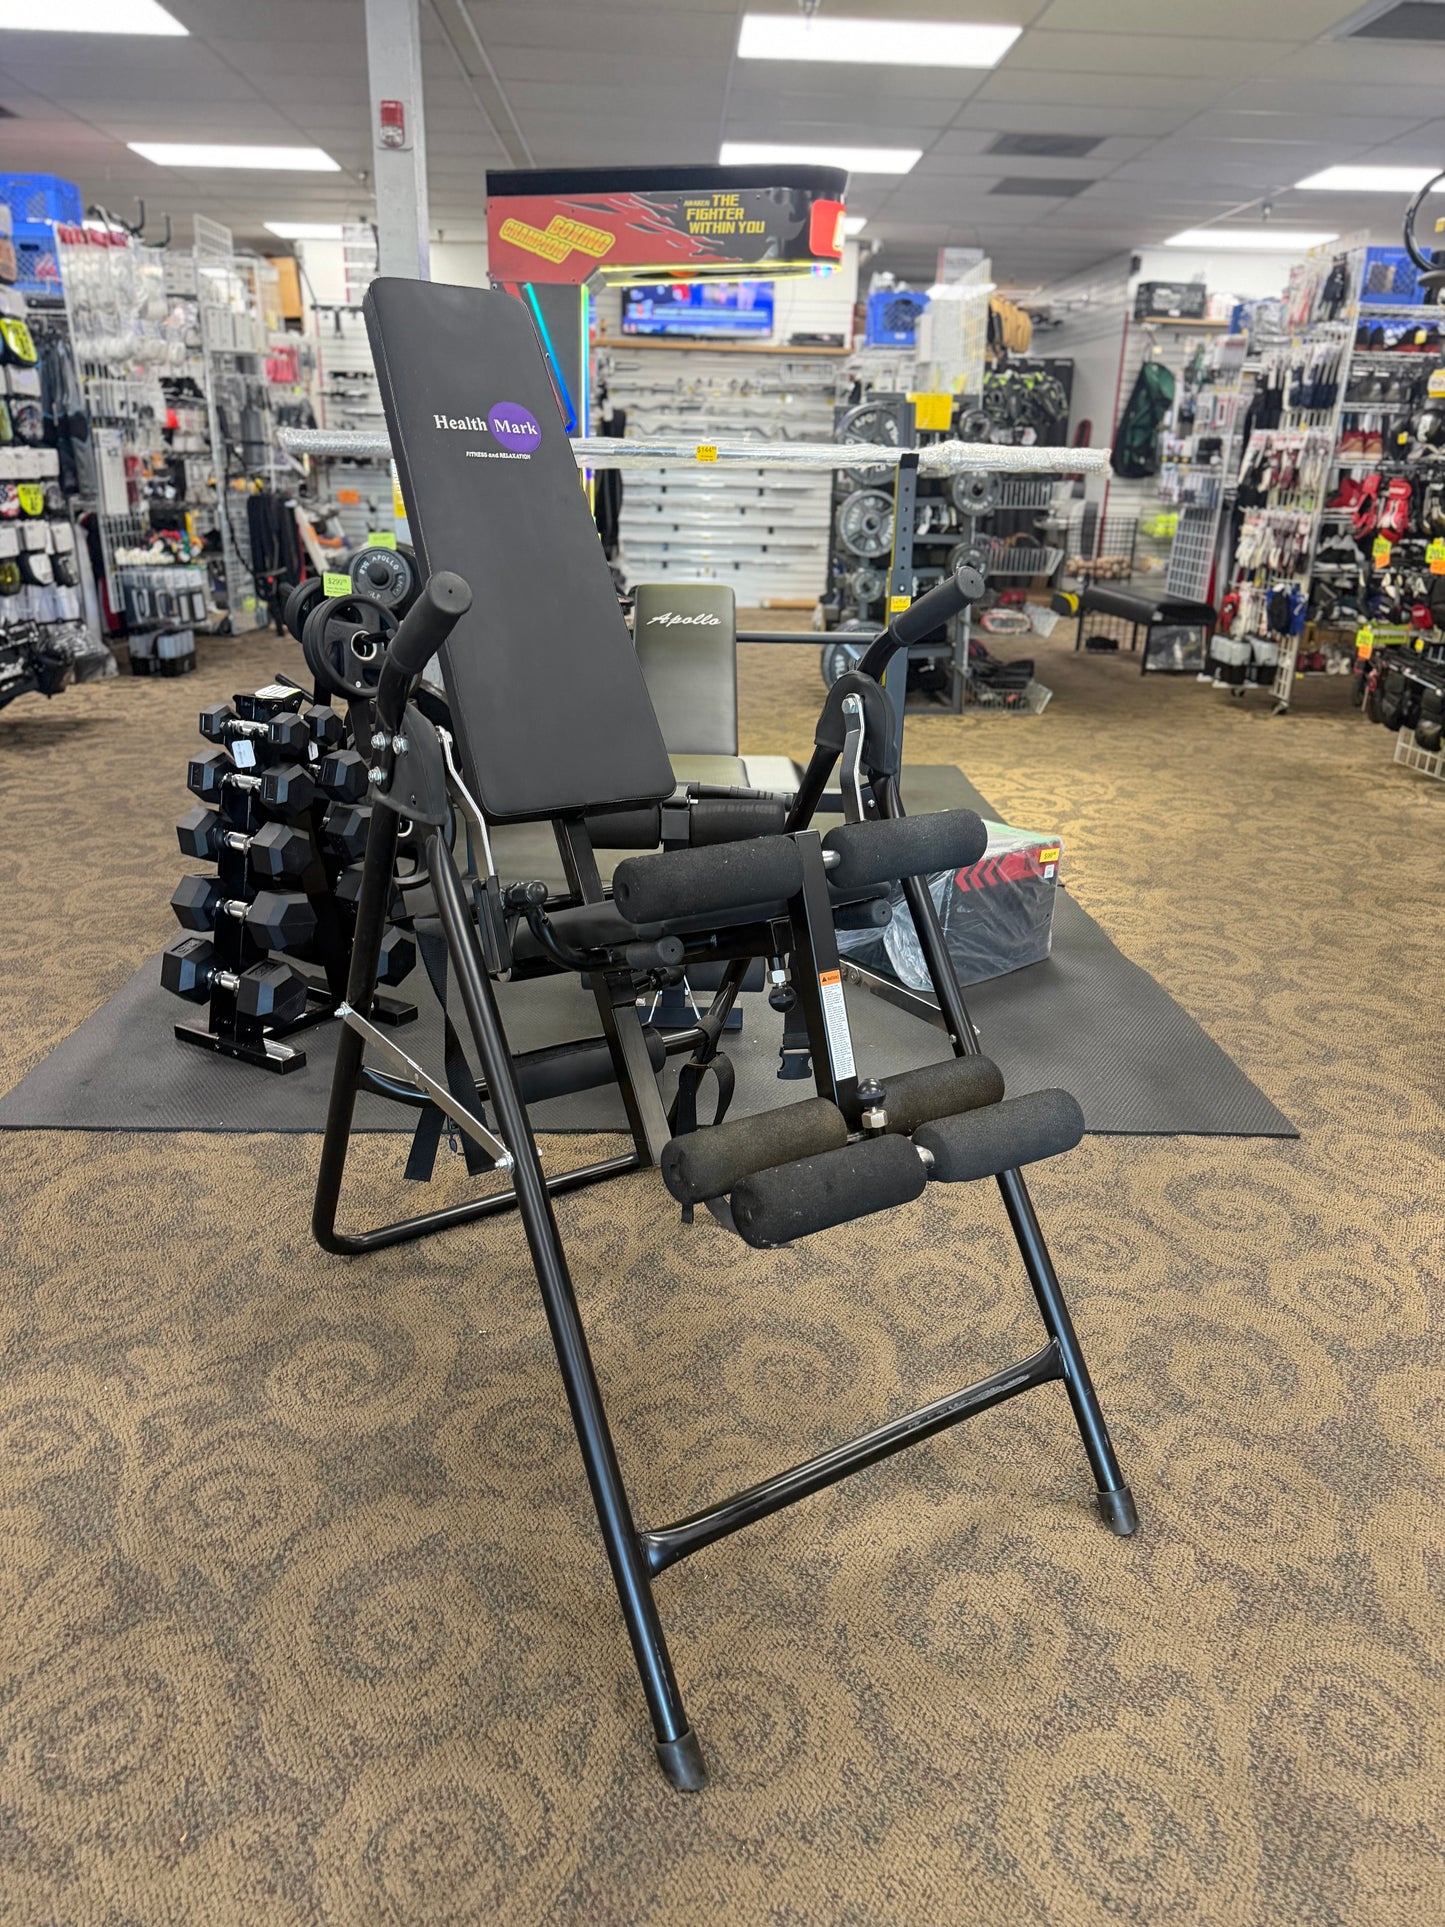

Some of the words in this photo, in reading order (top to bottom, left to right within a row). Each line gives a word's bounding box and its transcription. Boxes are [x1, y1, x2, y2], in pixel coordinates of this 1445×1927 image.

[712, 194, 740, 206] THE
[686, 207, 744, 221] FIGHTER
[549, 218, 611, 253] BOXING
[689, 221, 736, 234] WITHIN
[738, 221, 765, 234] YOU
[503, 221, 570, 258] CHAMPION
[433, 414, 488, 432] Health
[493, 418, 538, 435] Mark
[500, 452, 531, 460] RELAXATION
[371, 554, 399, 570] APOLLO
[646, 611, 722, 628] Apollo
